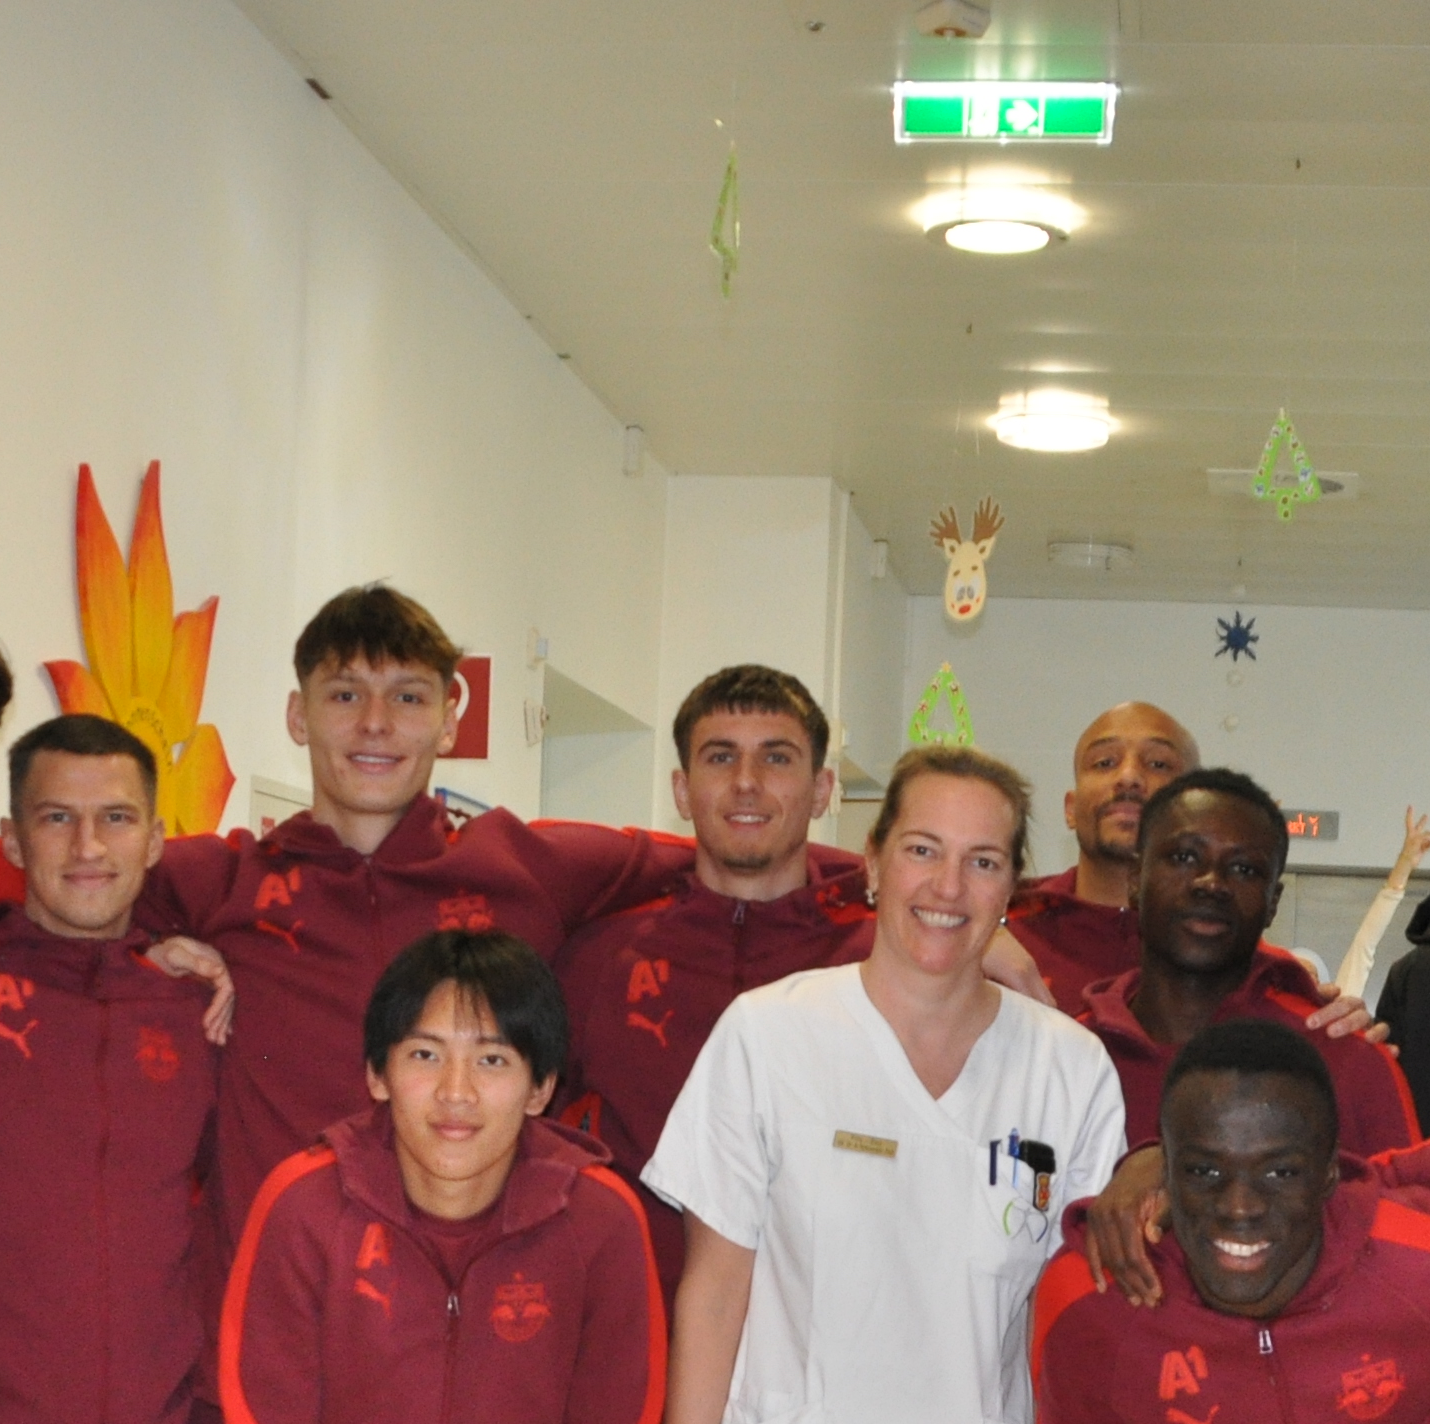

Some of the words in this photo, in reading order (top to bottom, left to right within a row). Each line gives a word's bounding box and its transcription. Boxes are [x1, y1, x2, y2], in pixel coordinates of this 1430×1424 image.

[627, 958, 670, 1003] A1
[355, 1221, 391, 1270] A
[1158, 1345, 1209, 1400] A1
